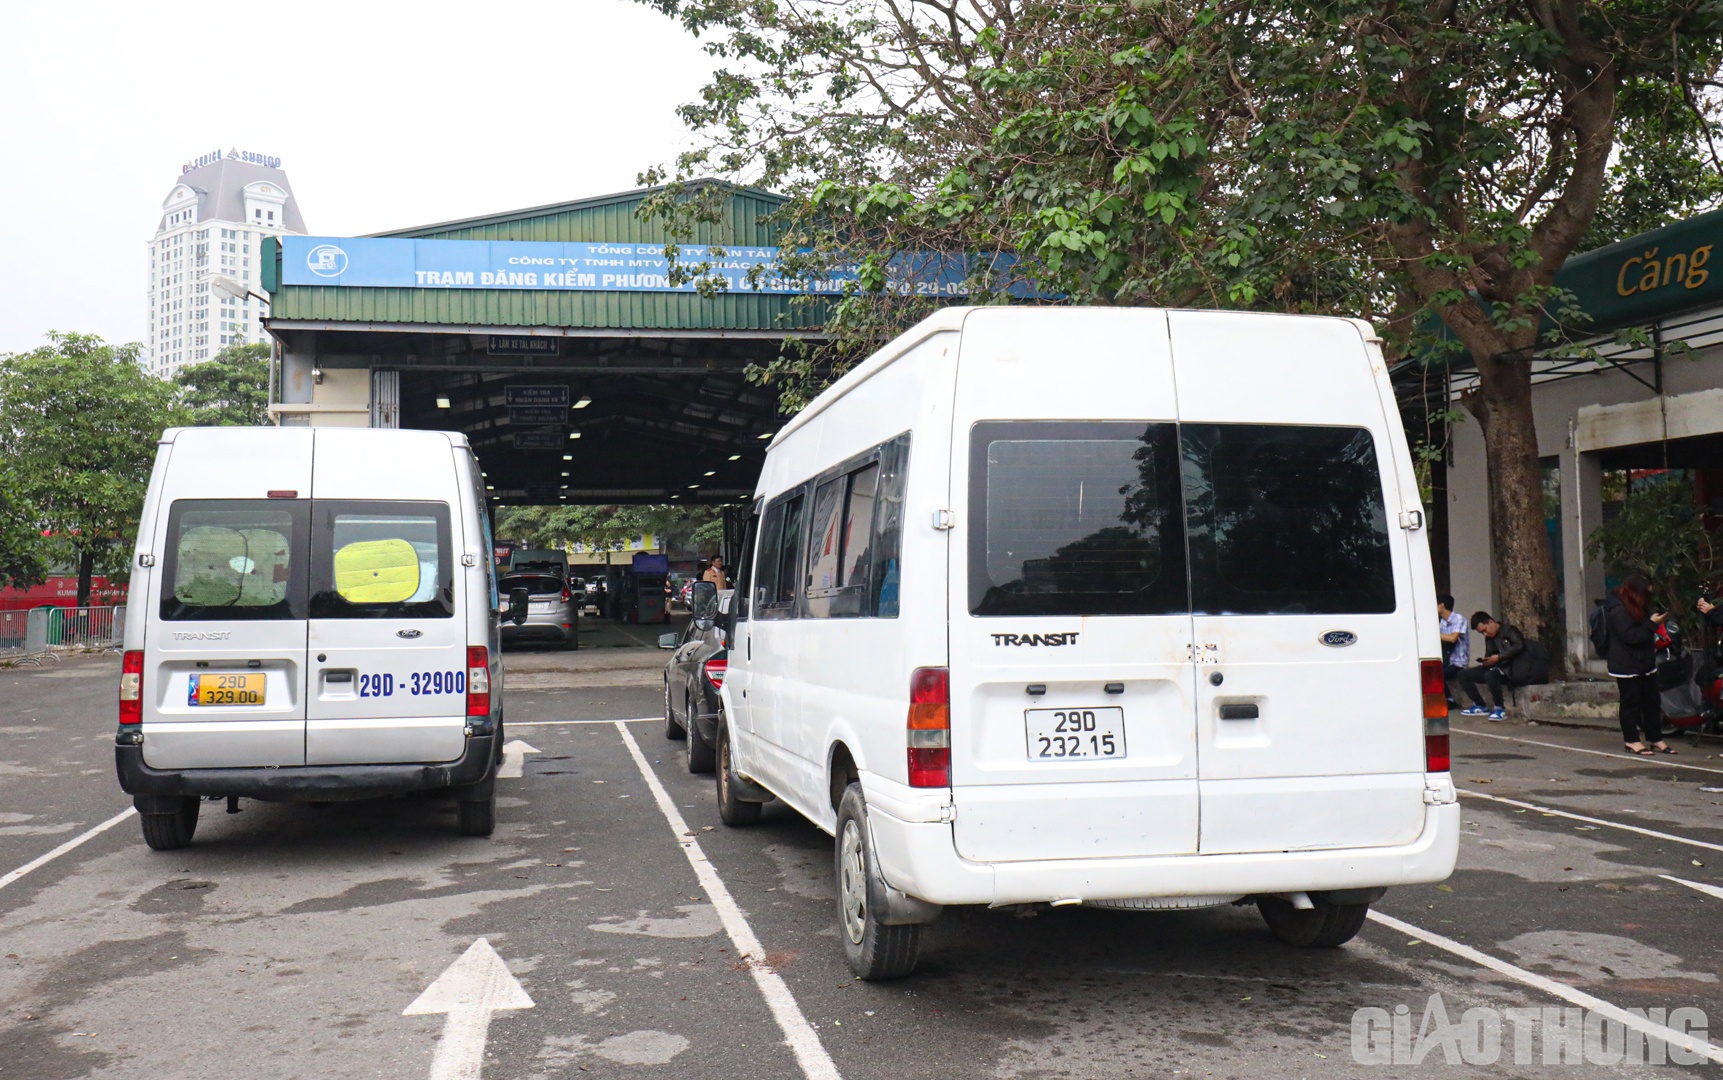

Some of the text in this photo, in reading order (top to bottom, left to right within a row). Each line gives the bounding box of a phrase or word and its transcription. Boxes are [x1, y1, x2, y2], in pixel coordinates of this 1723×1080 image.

[588, 243, 632, 255] TỔNG
[684, 248, 704, 256] TY
[508, 255, 554, 265] CÔNG
[558, 257, 579, 266] TY
[583, 258, 624, 267] TNHH
[628, 259, 664, 268] MTV
[480, 268, 538, 287] ĐĂNG
[543, 267, 596, 288] KIỂM
[1617, 245, 1714, 297] Căng
[172, 631, 231, 641] TRANSIT
[990, 632, 1080, 647] TRANSIT
[218, 676, 247, 689] 29D
[360, 673, 394, 698] 29D
[411, 671, 465, 696] 32900
[206, 690, 258, 704] 329.00
[1053, 711, 1096, 733] 29D
[1038, 734, 1117, 758] 232.15
